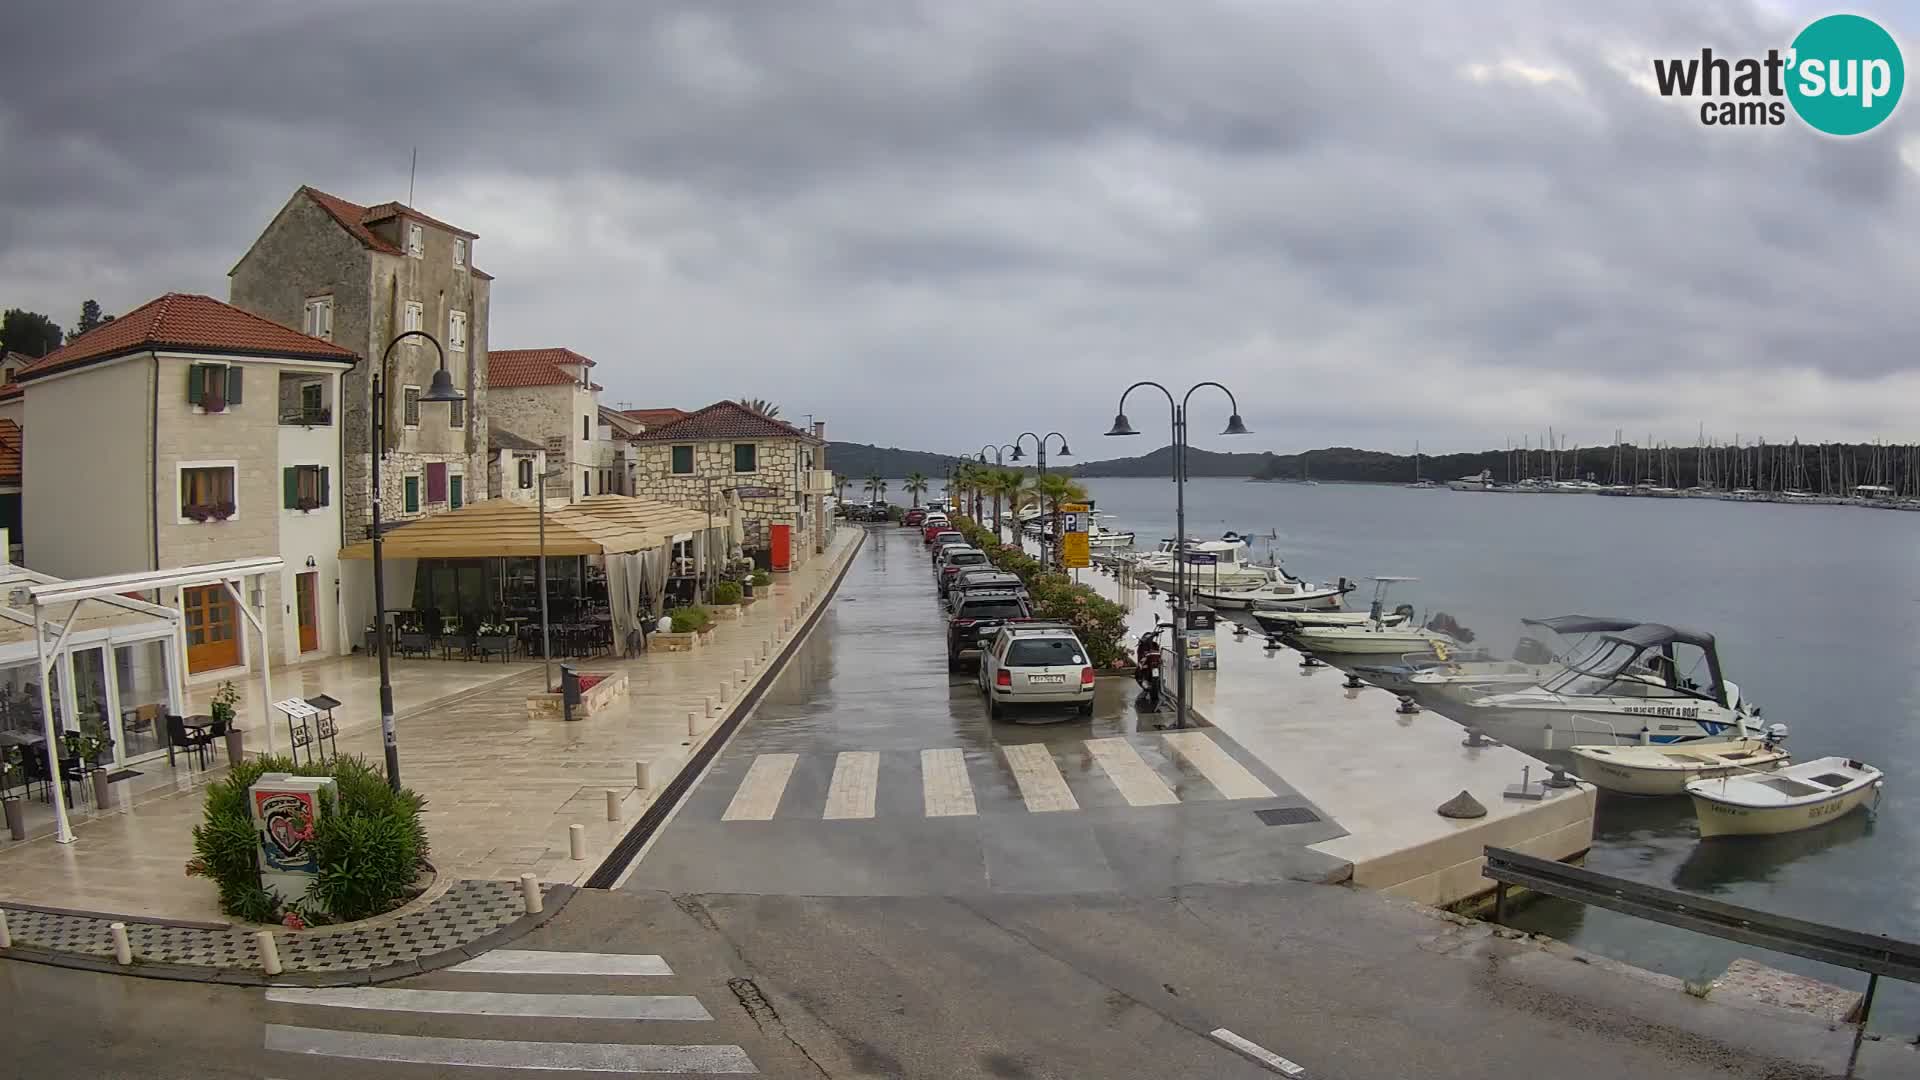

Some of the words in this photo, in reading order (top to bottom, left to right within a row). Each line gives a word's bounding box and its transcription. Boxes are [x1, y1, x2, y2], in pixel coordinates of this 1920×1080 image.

[1065, 515, 1076, 531] P
[1657, 706, 1675, 716] RENT
[1682, 706, 1699, 718] BOAT
